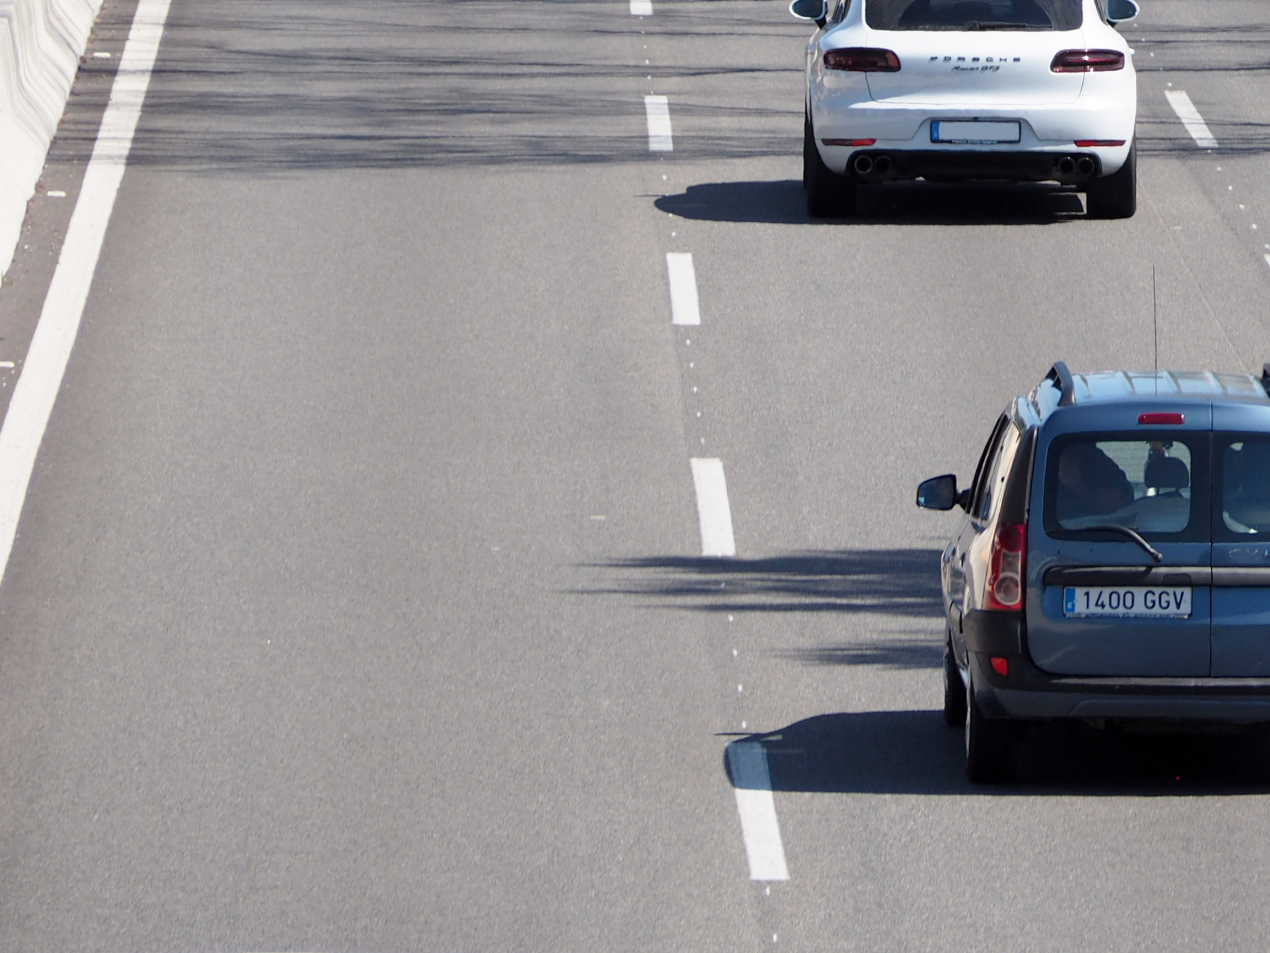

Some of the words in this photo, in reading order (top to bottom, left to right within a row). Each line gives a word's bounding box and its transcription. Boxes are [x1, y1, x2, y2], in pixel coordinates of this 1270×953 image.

[929, 55, 1021, 63] PORSCHE
[1083, 590, 1135, 610] 1400
[1143, 590, 1185, 610] GGV
